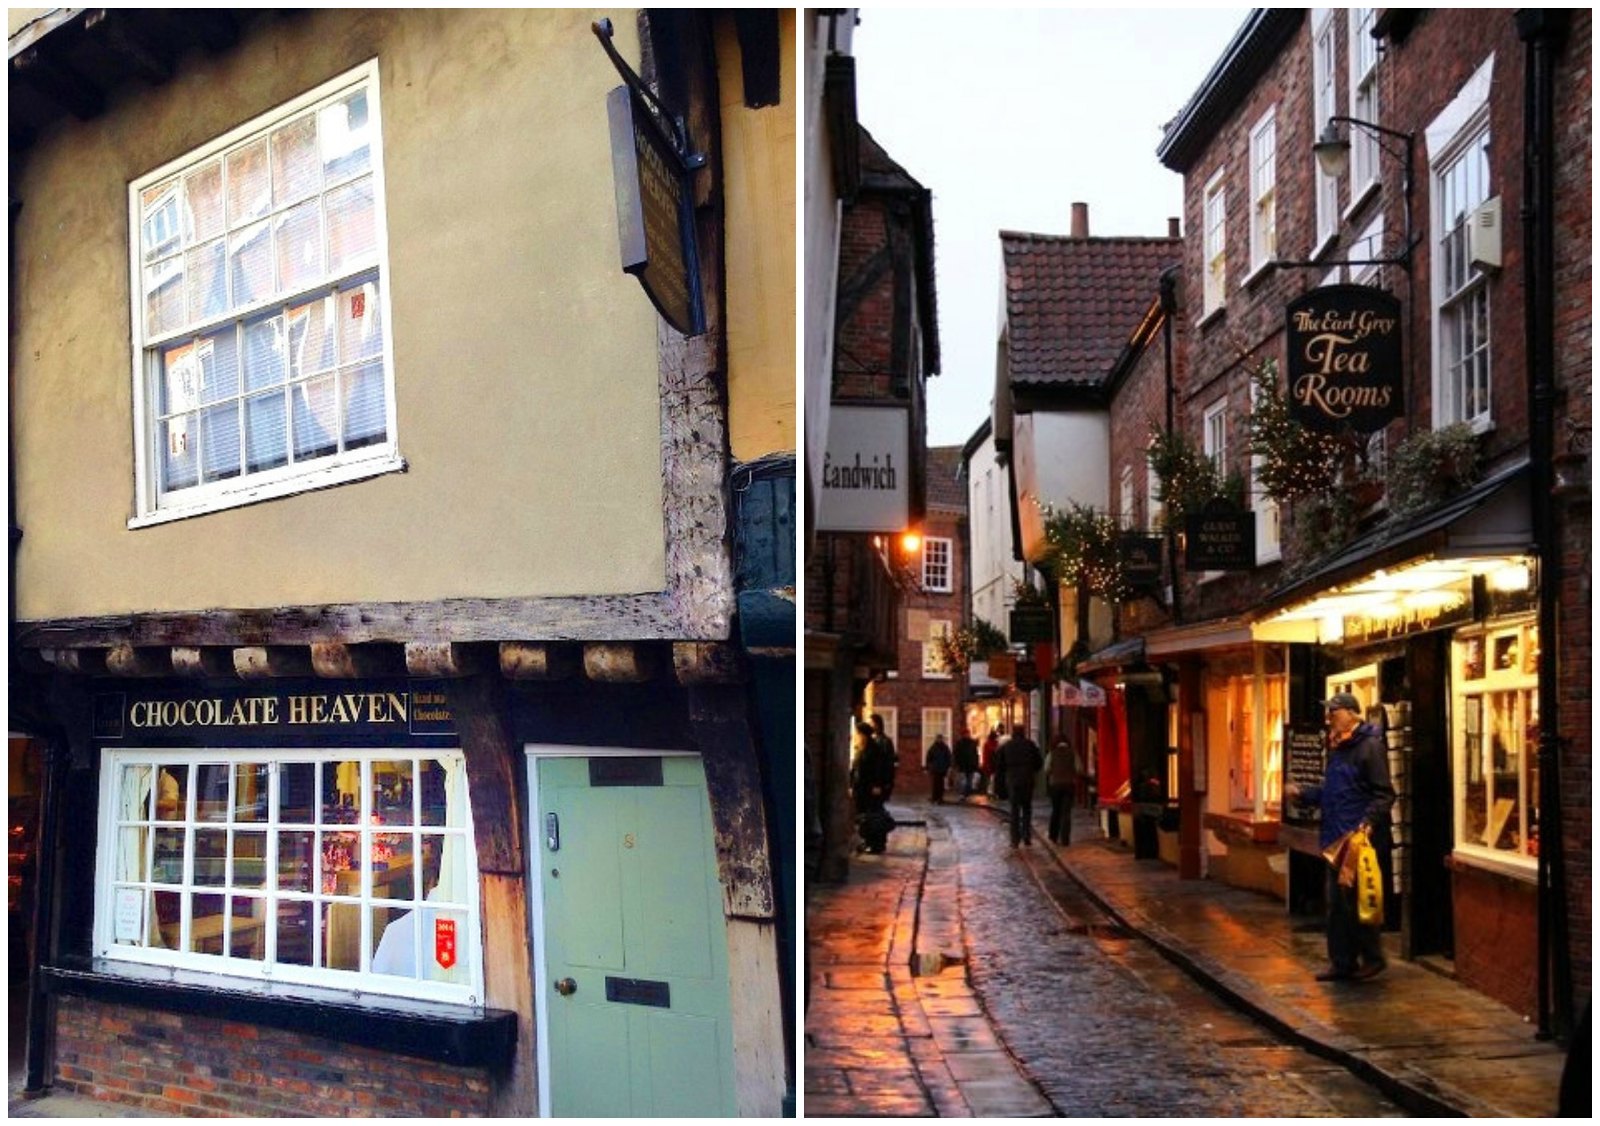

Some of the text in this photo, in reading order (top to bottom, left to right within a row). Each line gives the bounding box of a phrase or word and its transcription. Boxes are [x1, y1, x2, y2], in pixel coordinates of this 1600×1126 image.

[1292, 308, 1395, 338] The Earl Grey
[1304, 333, 1371, 375] Tea
[1292, 373, 1393, 418] Rooms
[129, 692, 409, 728] CHOCOLATE HEAVEN
